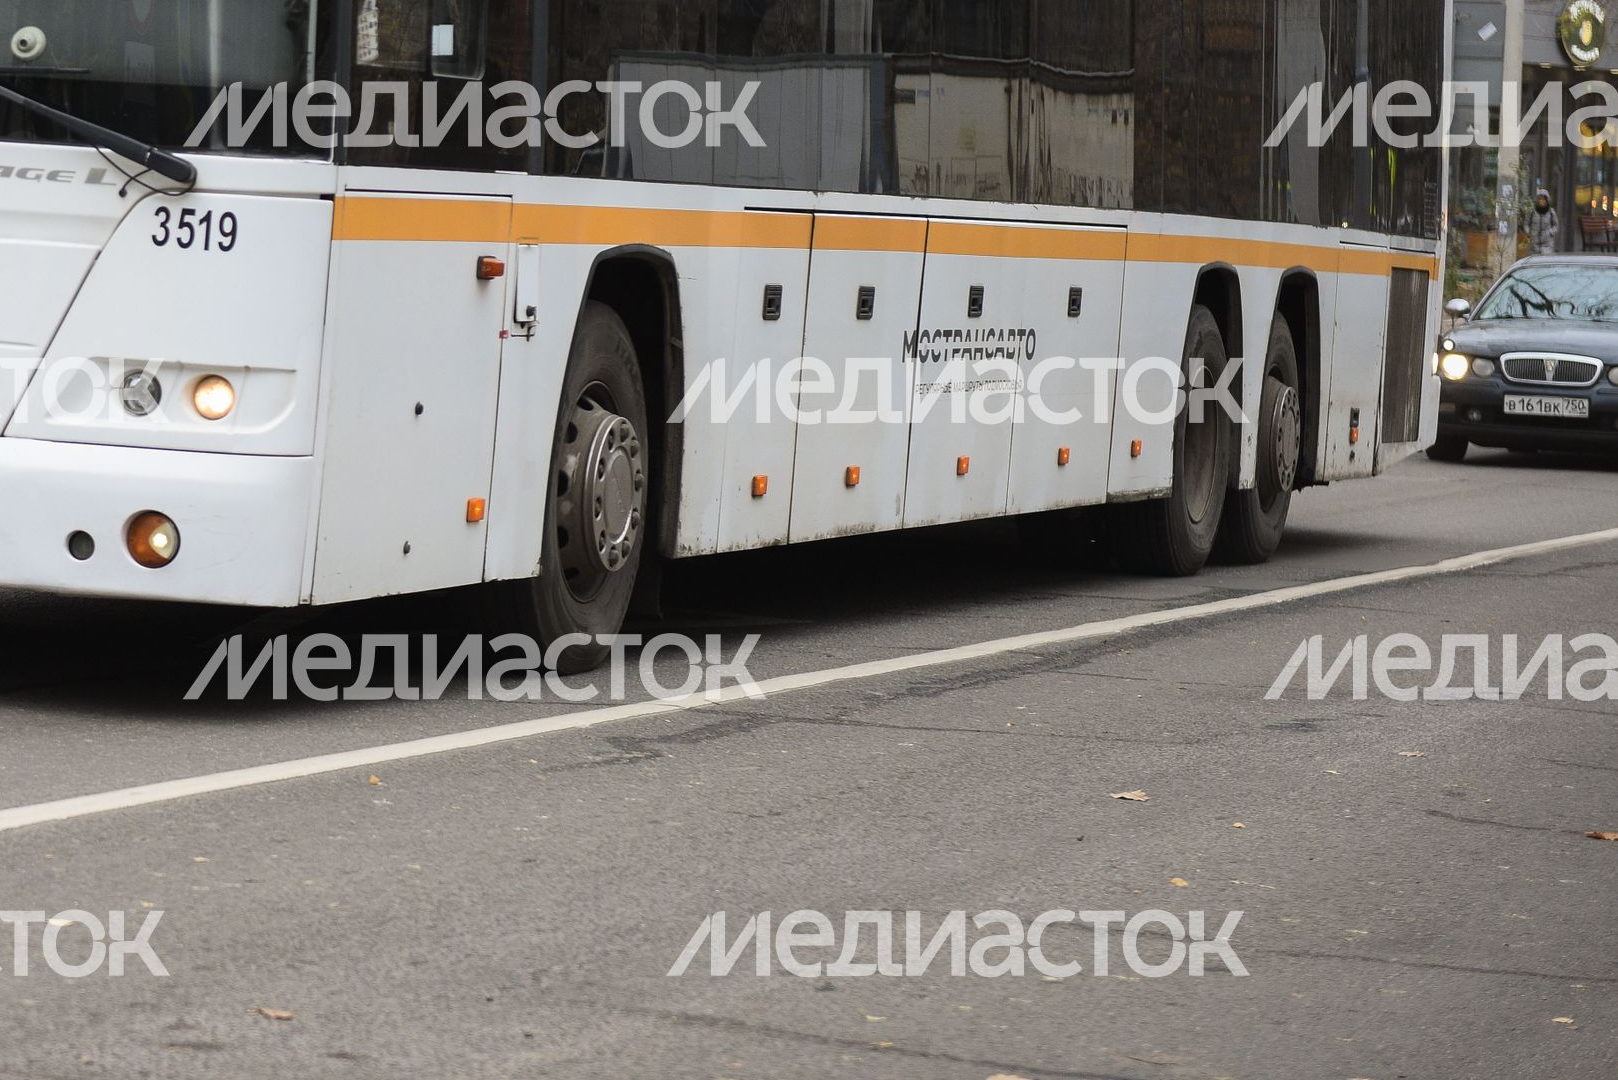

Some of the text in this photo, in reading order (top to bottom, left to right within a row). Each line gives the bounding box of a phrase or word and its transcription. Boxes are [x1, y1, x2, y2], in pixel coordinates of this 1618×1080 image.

[84, 167, 117, 186] L
[151, 206, 239, 252] 3519
[902, 327, 1037, 363] МОСТРАНСАВТО
